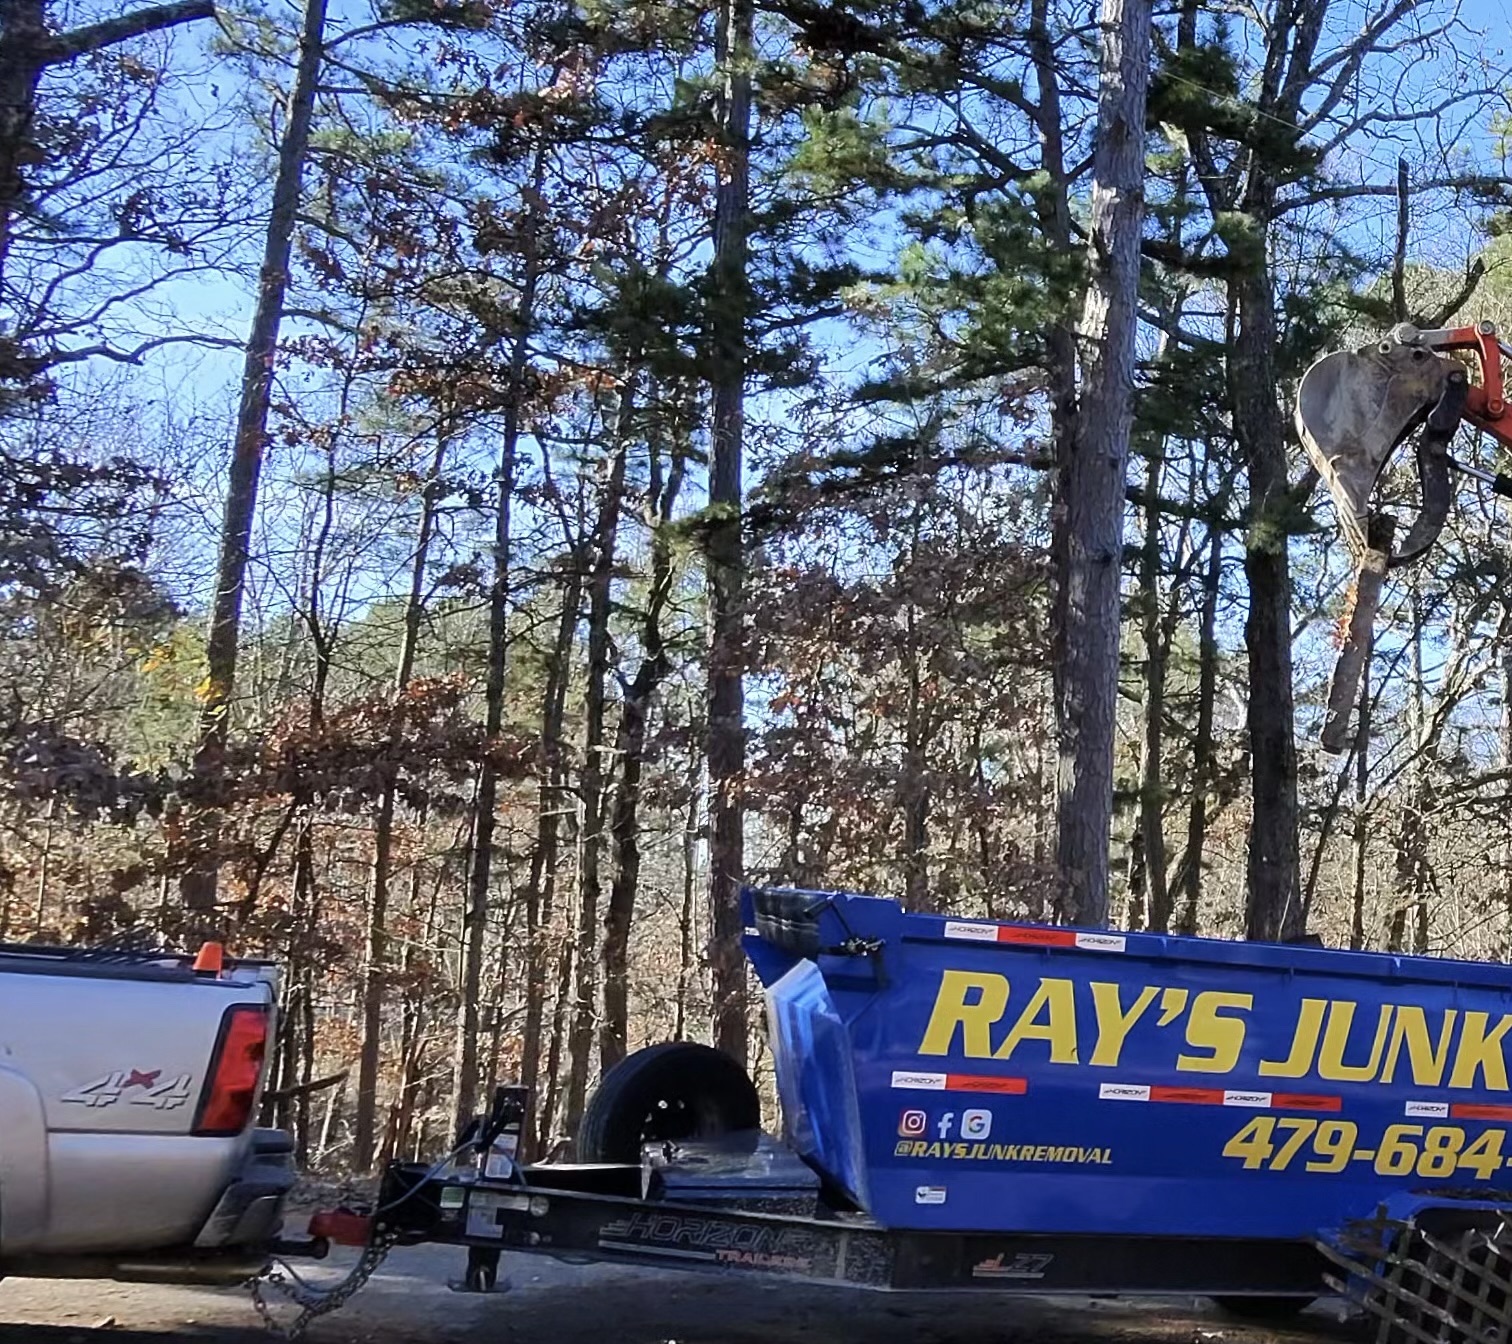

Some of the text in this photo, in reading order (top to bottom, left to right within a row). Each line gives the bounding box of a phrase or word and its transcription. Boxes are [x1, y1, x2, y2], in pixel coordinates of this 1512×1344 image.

[917, 970, 1254, 1074] RAY'S
[894, 1139, 1114, 1165] @RAYSJUNKREMOVAL
[622, 1212, 803, 1251] HORIZON
